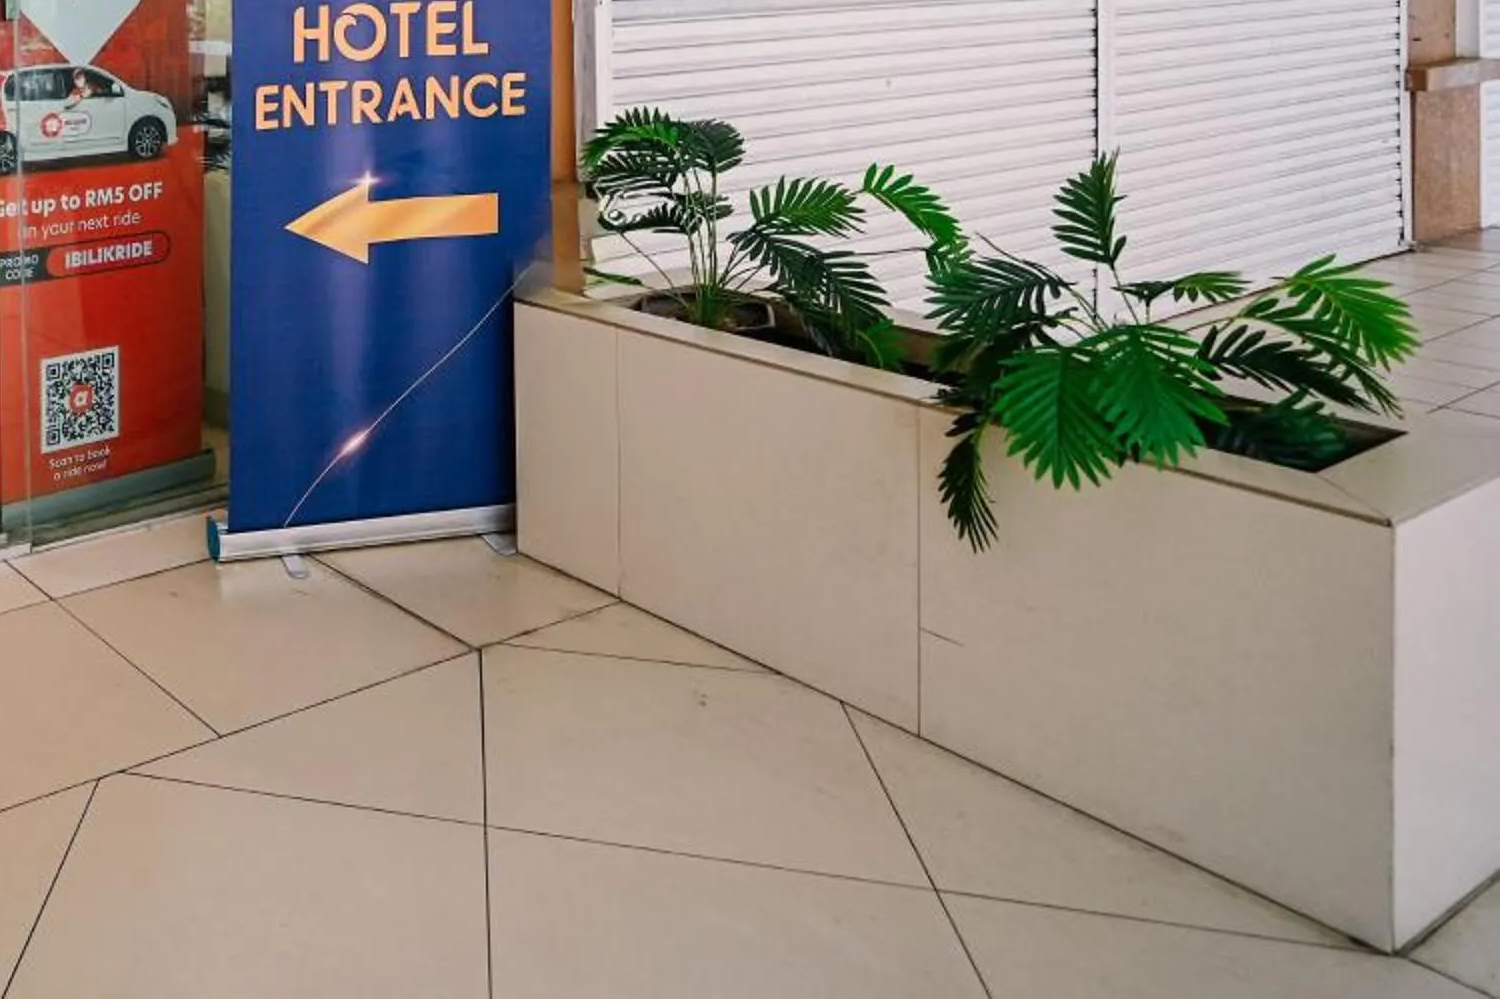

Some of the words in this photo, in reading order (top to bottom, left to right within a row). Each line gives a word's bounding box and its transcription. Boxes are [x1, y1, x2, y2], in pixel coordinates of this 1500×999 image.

[293, 0, 489, 63] HOTEL
[255, 72, 527, 131] ENTRANCE
[31, 198, 56, 218] up
[60, 193, 81, 210] to
[85, 184, 125, 207] RM5
[128, 181, 164, 202] OFF
[41, 221, 76, 240] your
[78, 216, 113, 232] next
[113, 210, 142, 227] ride
[64, 239, 153, 269] IBILIKRIDE
